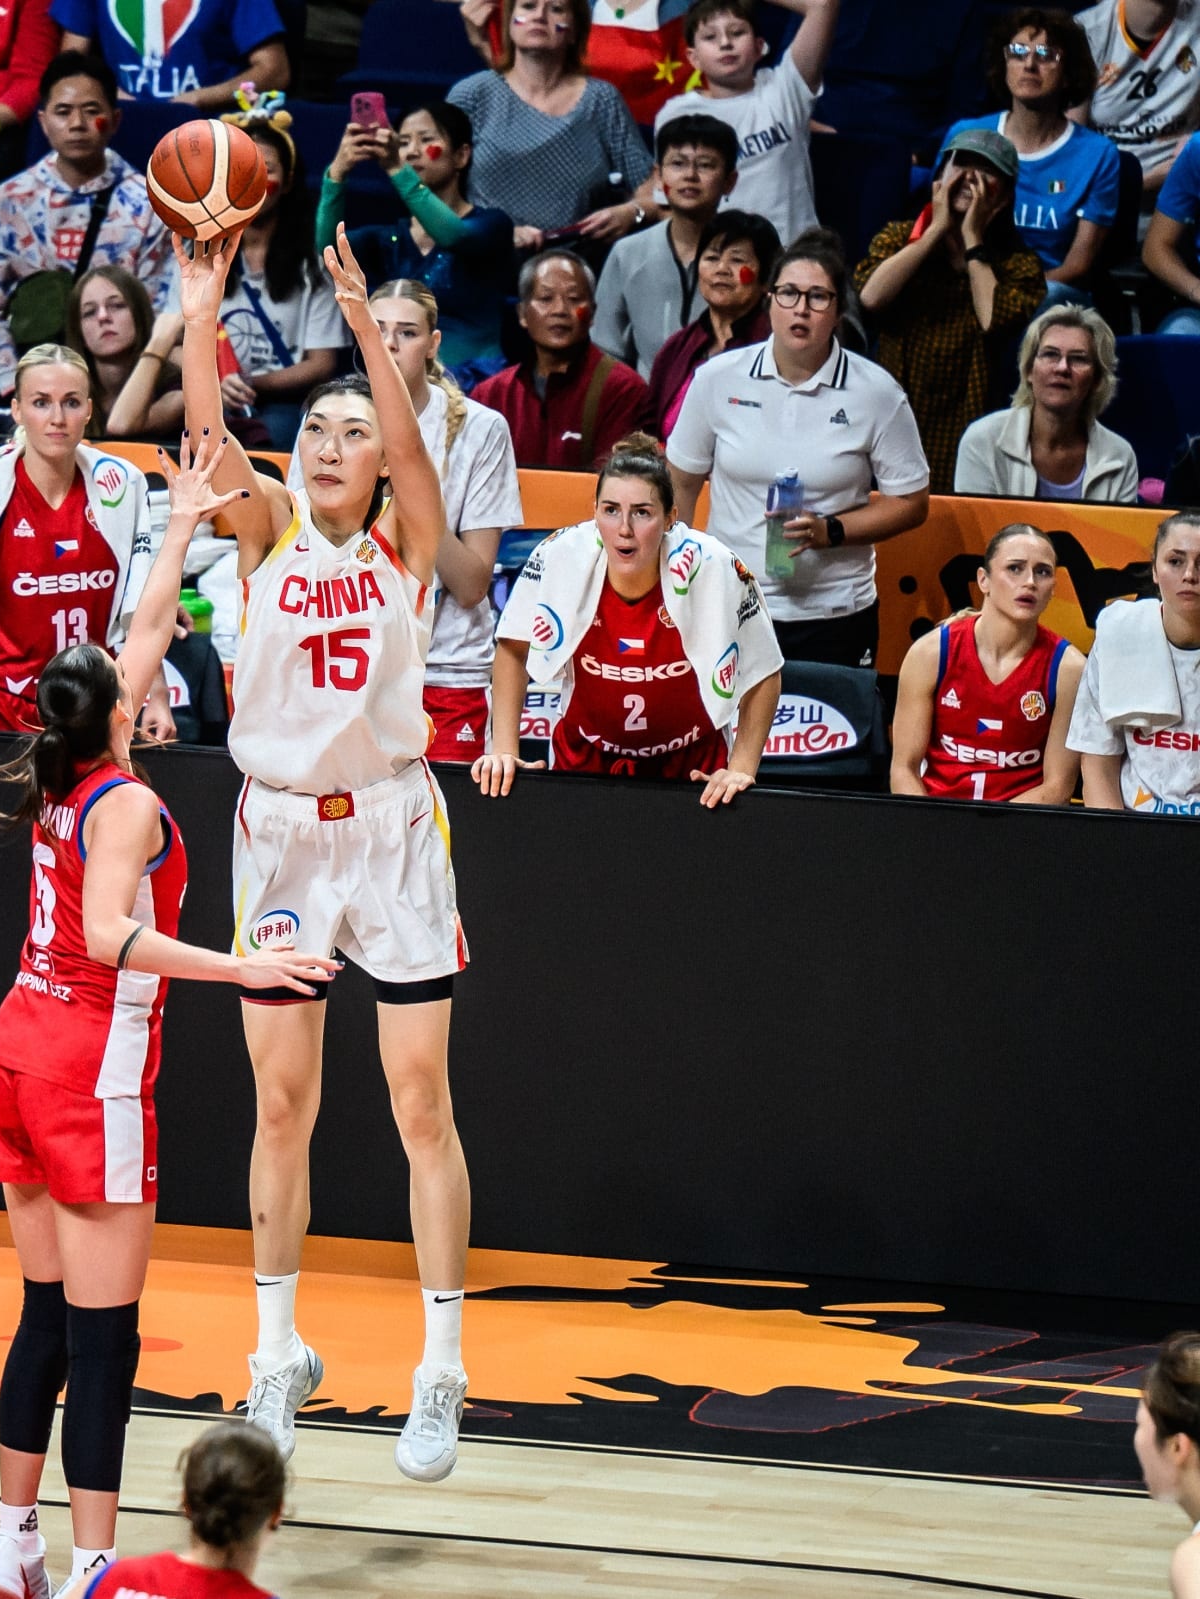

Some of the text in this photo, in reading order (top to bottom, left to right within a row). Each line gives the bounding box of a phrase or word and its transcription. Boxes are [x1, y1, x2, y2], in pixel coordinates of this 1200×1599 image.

[1127, 68, 1162, 100] 26
[97, 468, 121, 496] Yili
[12, 569, 115, 597] ČESKO
[278, 570, 385, 618] CHINA
[51, 607, 88, 654] 13
[298, 627, 371, 691] 15
[580, 653, 692, 683] ČESKO
[623, 694, 648, 731] 2
[940, 734, 1041, 768] ČESKO
[970, 772, 986, 800] 1
[256, 919, 292, 943] 伊利
